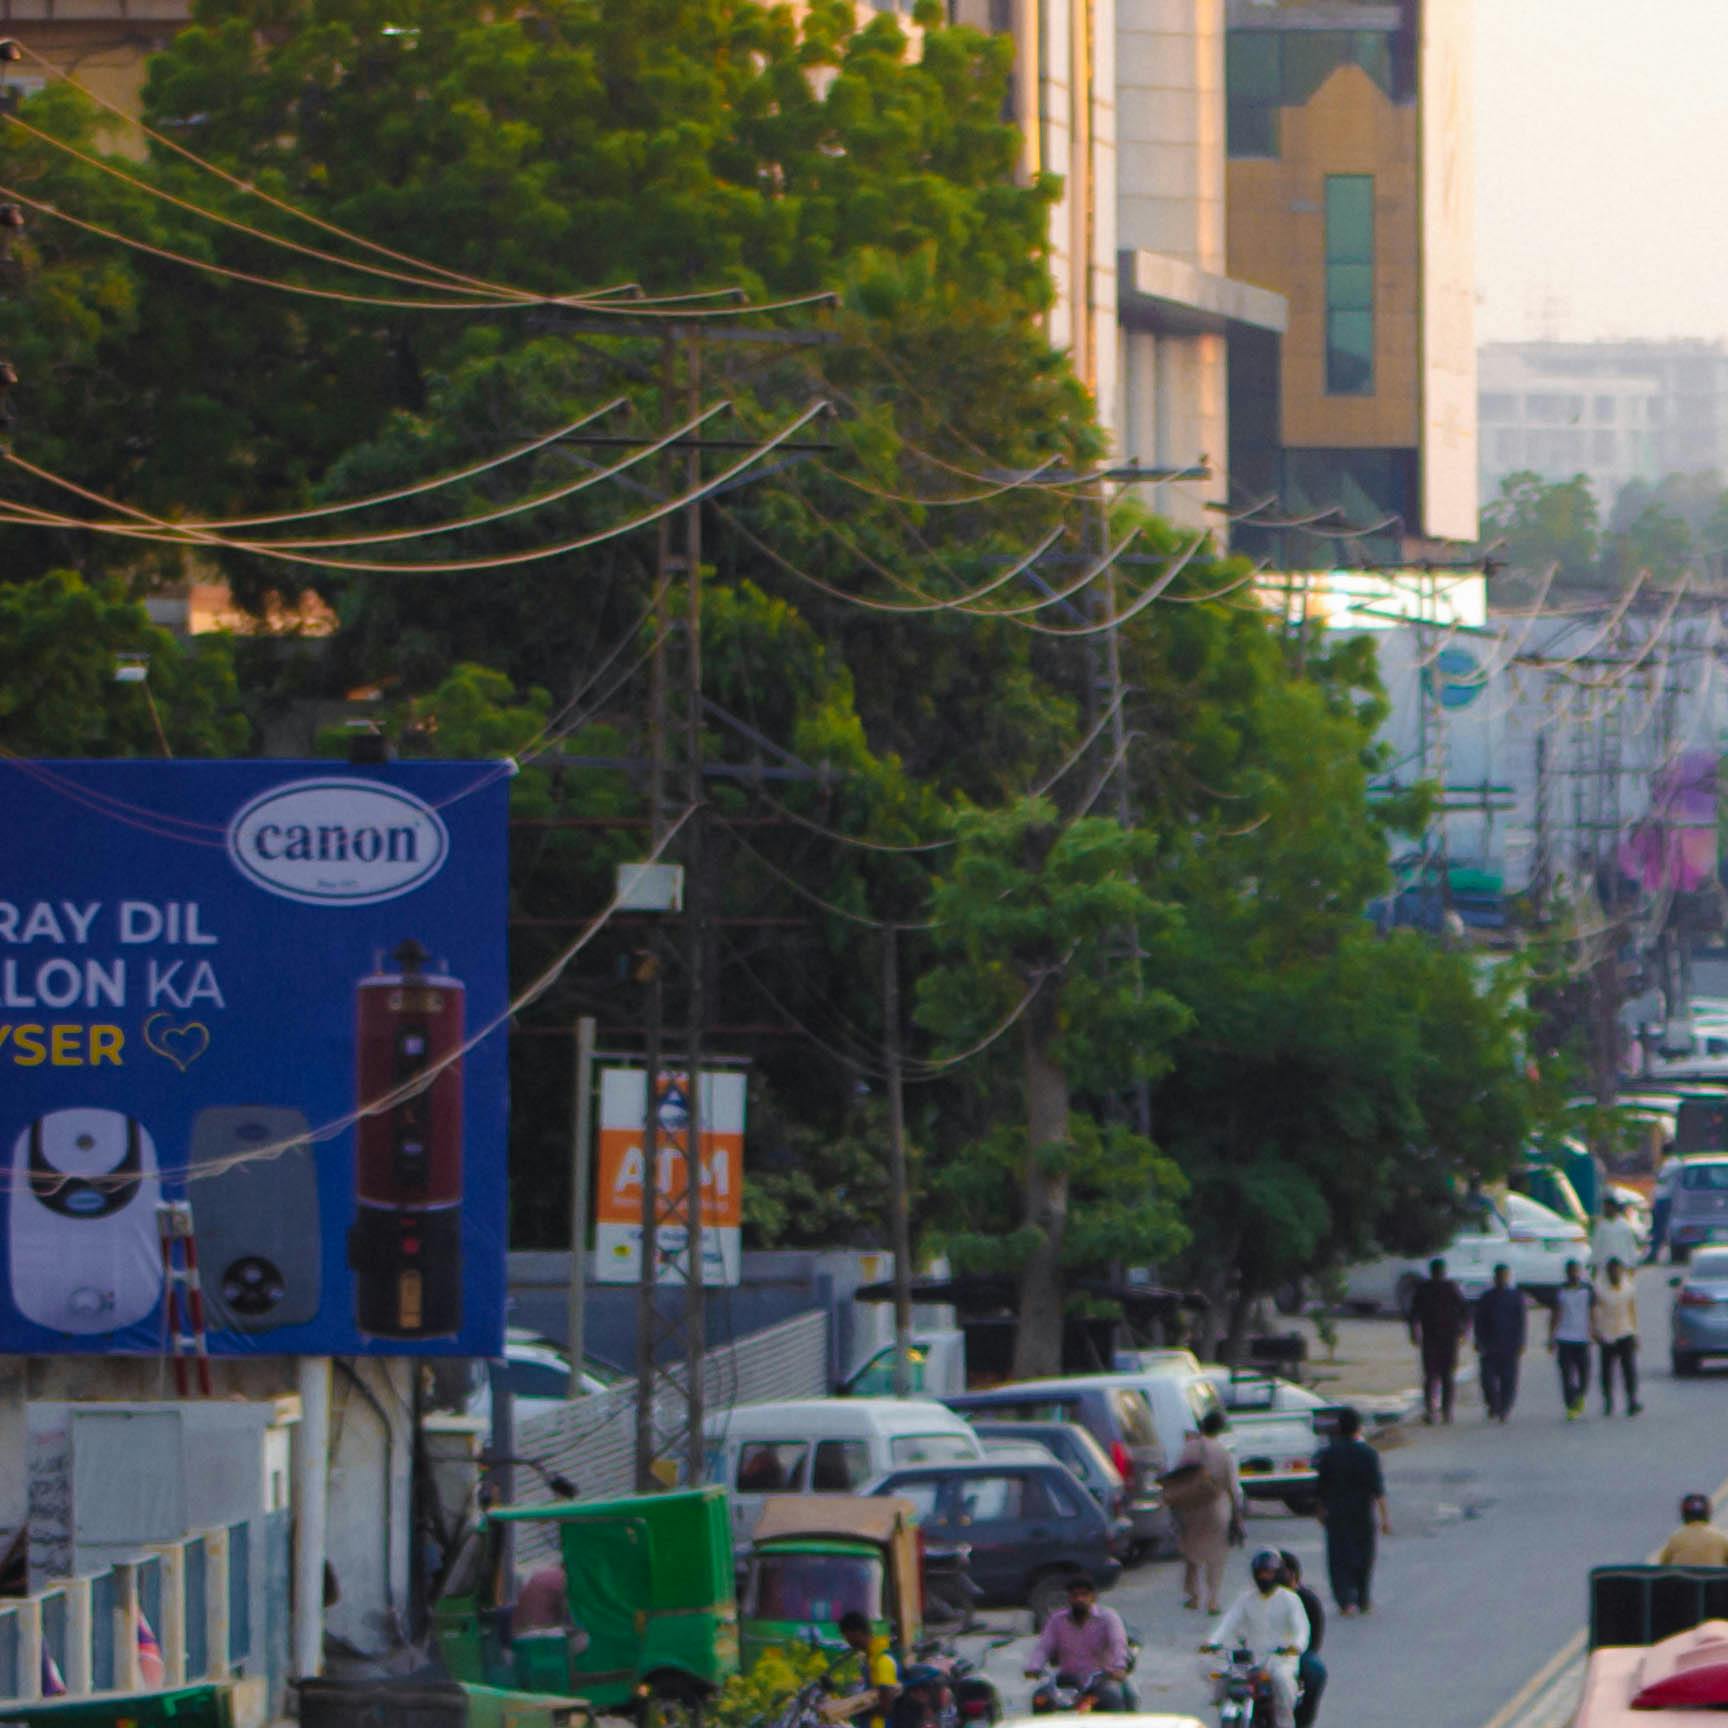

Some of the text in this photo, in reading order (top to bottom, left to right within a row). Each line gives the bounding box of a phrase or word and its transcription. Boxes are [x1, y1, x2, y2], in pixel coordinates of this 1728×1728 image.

[254, 821, 420, 863] canon
[120, 901, 218, 944] DIL
[149, 959, 226, 1008] KA
[613, 1146, 730, 1196] ATM
